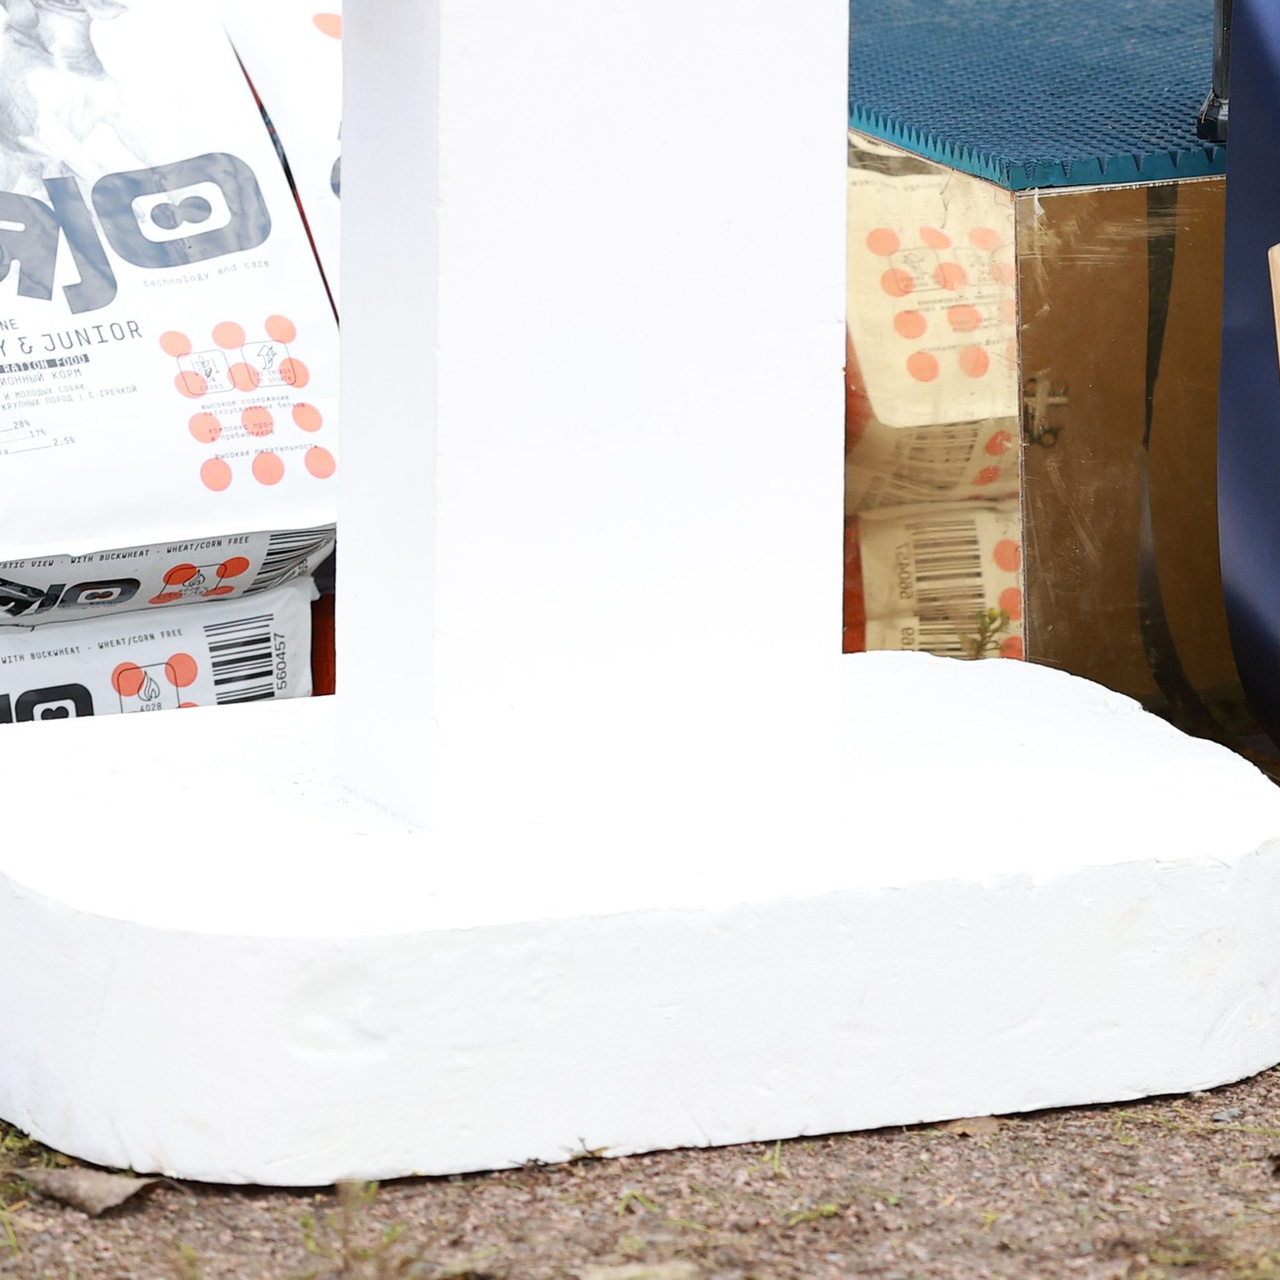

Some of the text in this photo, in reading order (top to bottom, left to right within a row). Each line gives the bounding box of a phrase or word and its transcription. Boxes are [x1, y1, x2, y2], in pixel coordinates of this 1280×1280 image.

[217, 263, 238, 276] and
[244, 260, 270, 270] care
[41, 320, 143, 352] JUNIOR
[56, 354, 88, 368] FOOD
[0, 368, 83, 388] ИОННЫЙ КОРМ
[15, 387, 53, 399] МОЛОДЫХ
[58, 383, 86, 393] СОБАК
[2, 397, 41, 411] КРУПНЫХ
[46, 394, 74, 405] ПОРОД
[201, 395, 289, 410] высокое содержание
[215, 450, 250, 460] высокая
[31, 560, 55, 568] VIEW
[70, 556, 94, 564] WITH
[99, 549, 151, 562] BUCKWHEAT
[166, 539, 223, 554] WHEAT/CORN
[228, 535, 251, 545] FREE
[1, 628, 184, 665] WITH BUCKWHEAT WHEAT/CORN FREE
[274, 632, 287, 690] 560457
